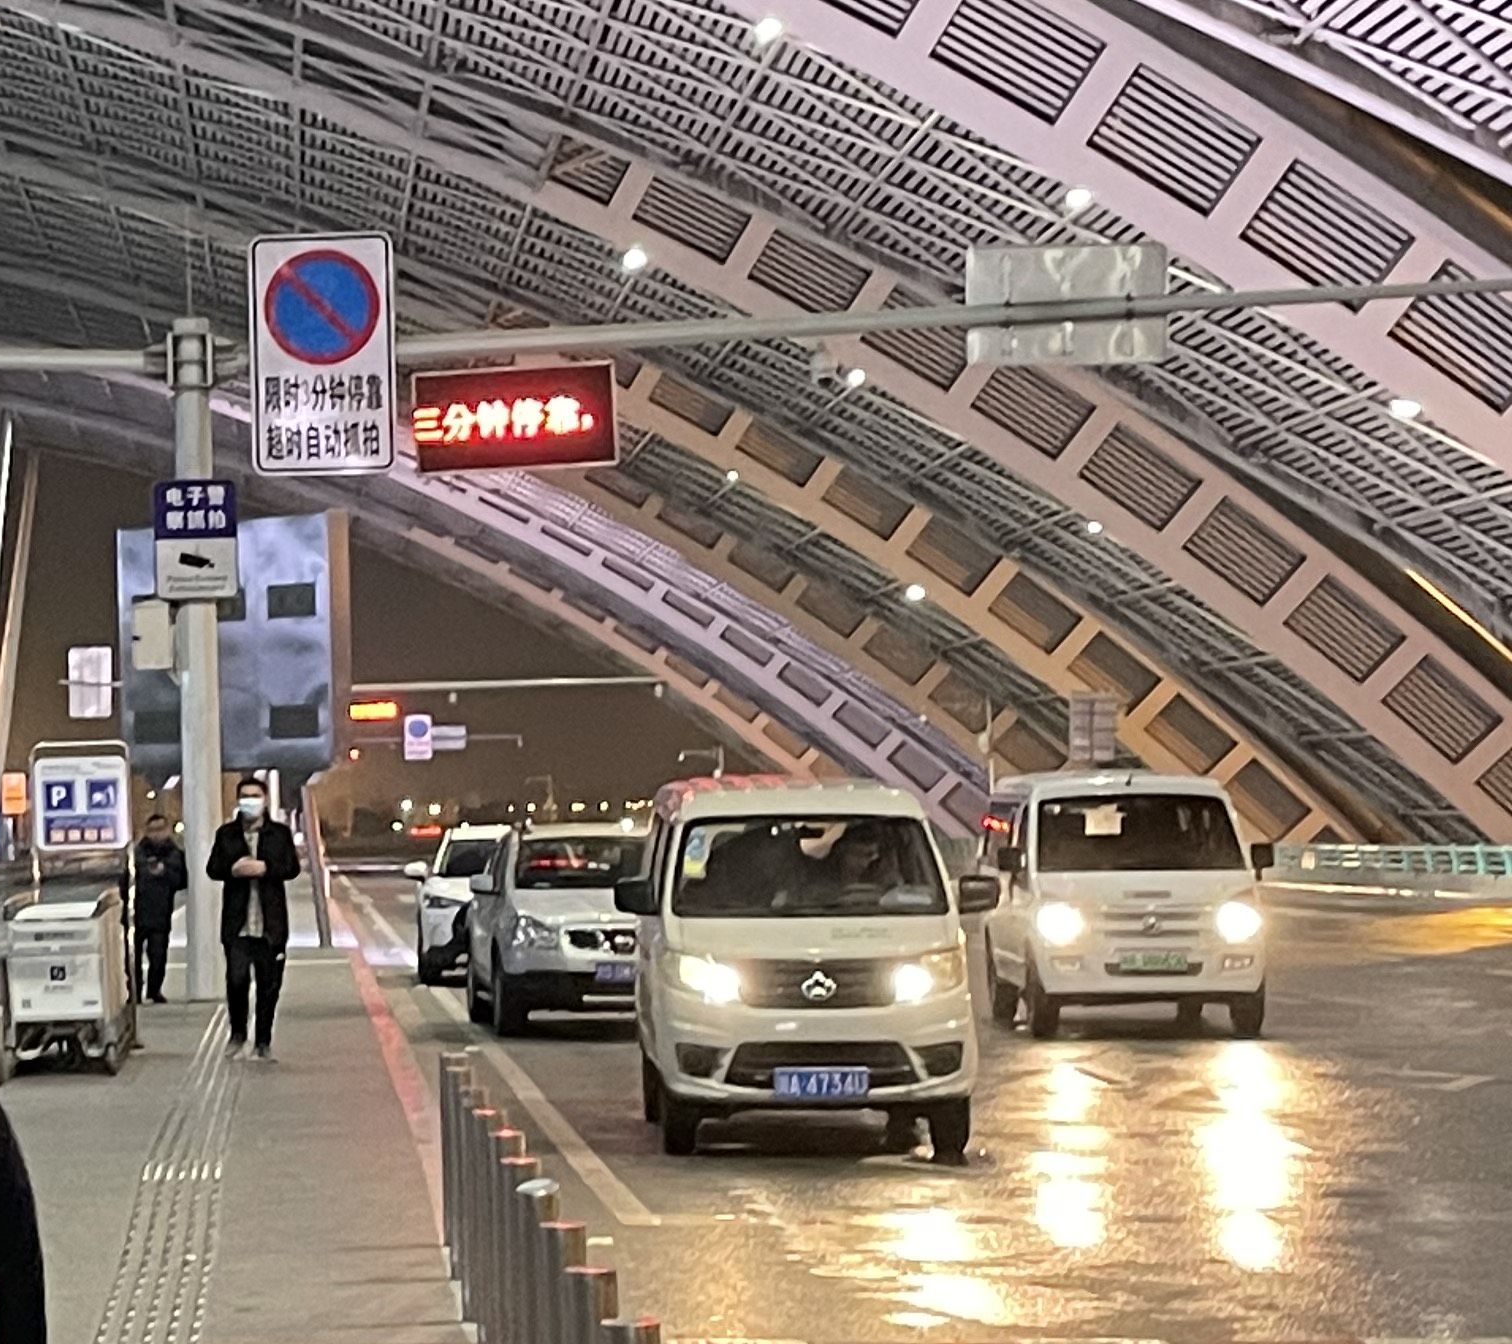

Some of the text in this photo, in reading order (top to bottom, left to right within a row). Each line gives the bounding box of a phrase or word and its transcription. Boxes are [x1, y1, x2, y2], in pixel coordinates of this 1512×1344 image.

[265, 374, 383, 413] 限时3分钟停靠
[267, 420, 381, 460] 超时自动抓拍
[51, 785, 67, 808] P
